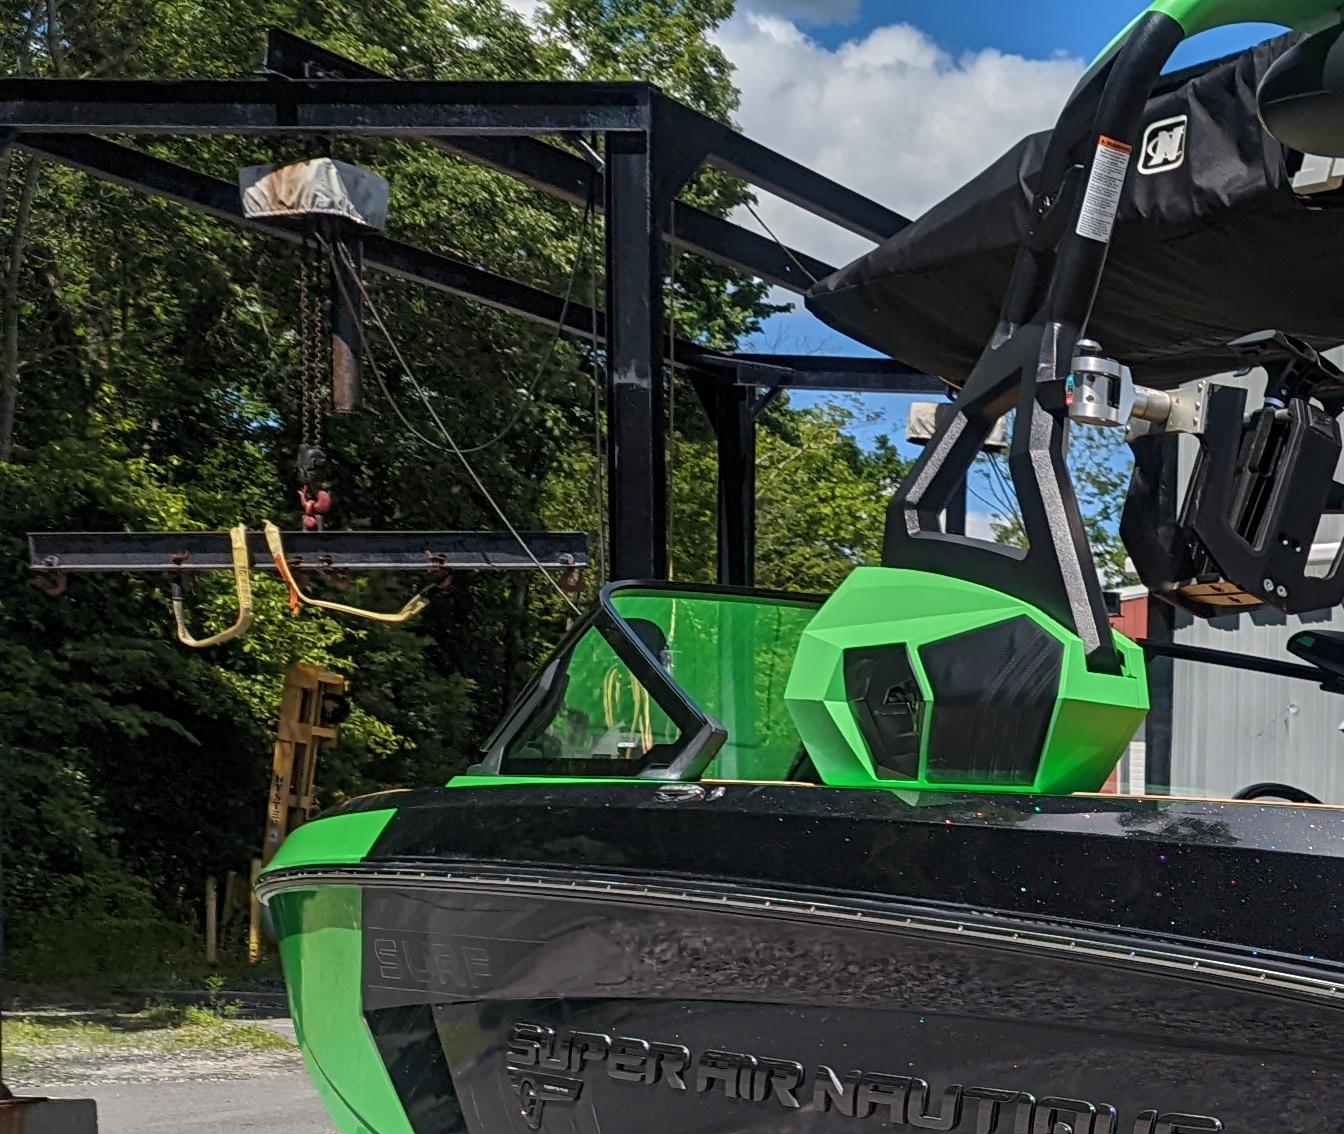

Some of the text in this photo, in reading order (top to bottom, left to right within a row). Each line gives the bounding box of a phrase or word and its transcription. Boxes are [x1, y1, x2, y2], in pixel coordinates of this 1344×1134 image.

[373, 938, 492, 989] SURF
[505, 1022, 690, 1092] SUPER
[696, 1049, 805, 1110] AIR
